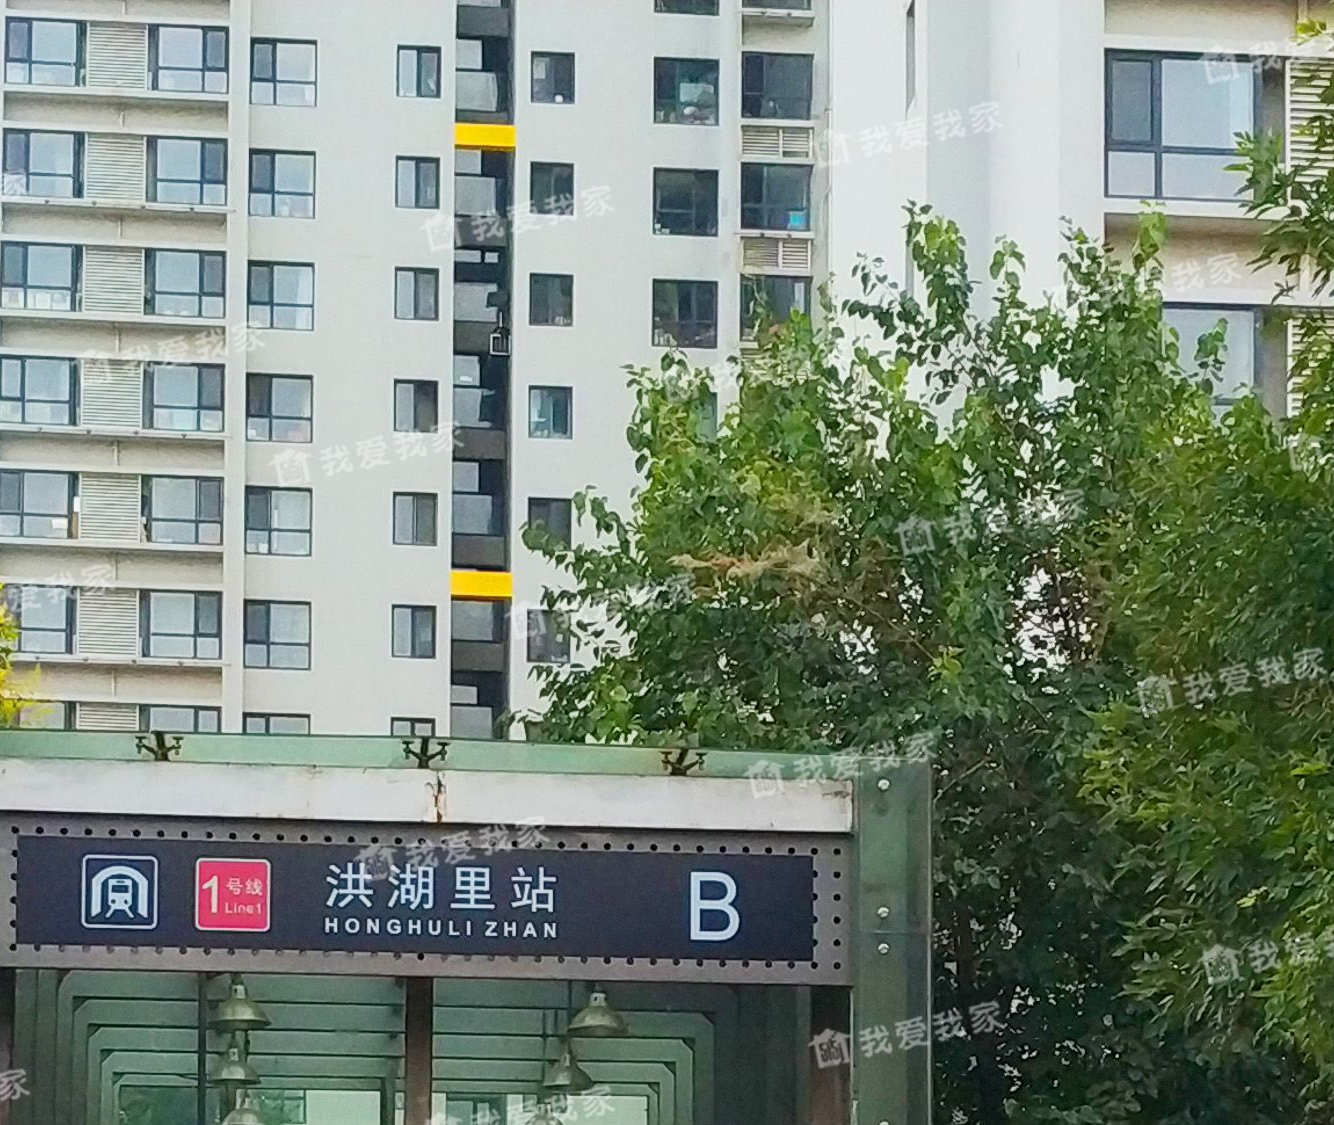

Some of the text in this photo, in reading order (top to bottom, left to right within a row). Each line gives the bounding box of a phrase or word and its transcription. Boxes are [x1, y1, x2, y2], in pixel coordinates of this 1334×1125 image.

[325, 862, 557, 913] 洪湖里站
[690, 871, 740, 941] B
[324, 917, 557, 938] HONGHULI ZHAN
